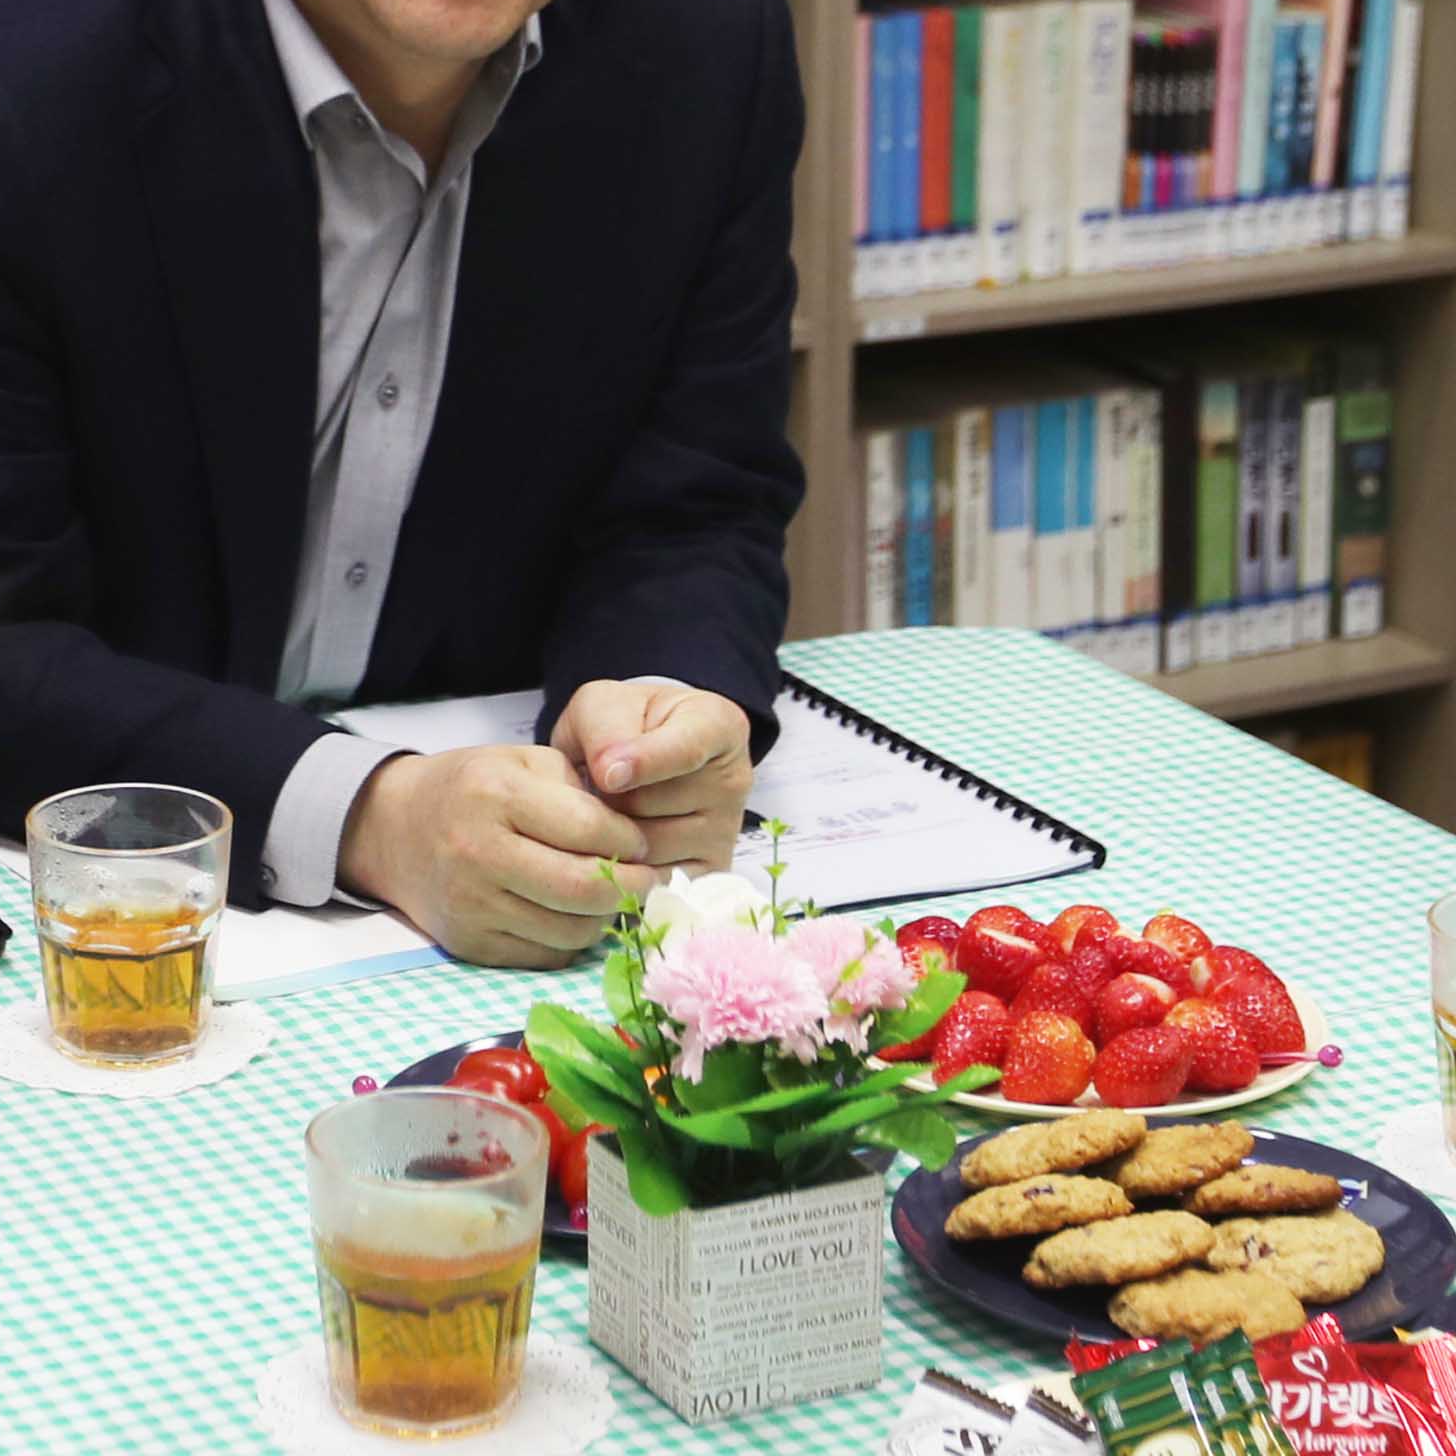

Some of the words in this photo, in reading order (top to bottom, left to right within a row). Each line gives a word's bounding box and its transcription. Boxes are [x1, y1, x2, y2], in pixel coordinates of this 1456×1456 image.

[591, 1202, 637, 1255] OREVER
[750, 1245, 801, 1276] LOVE
[809, 1235, 853, 1265] YOU
